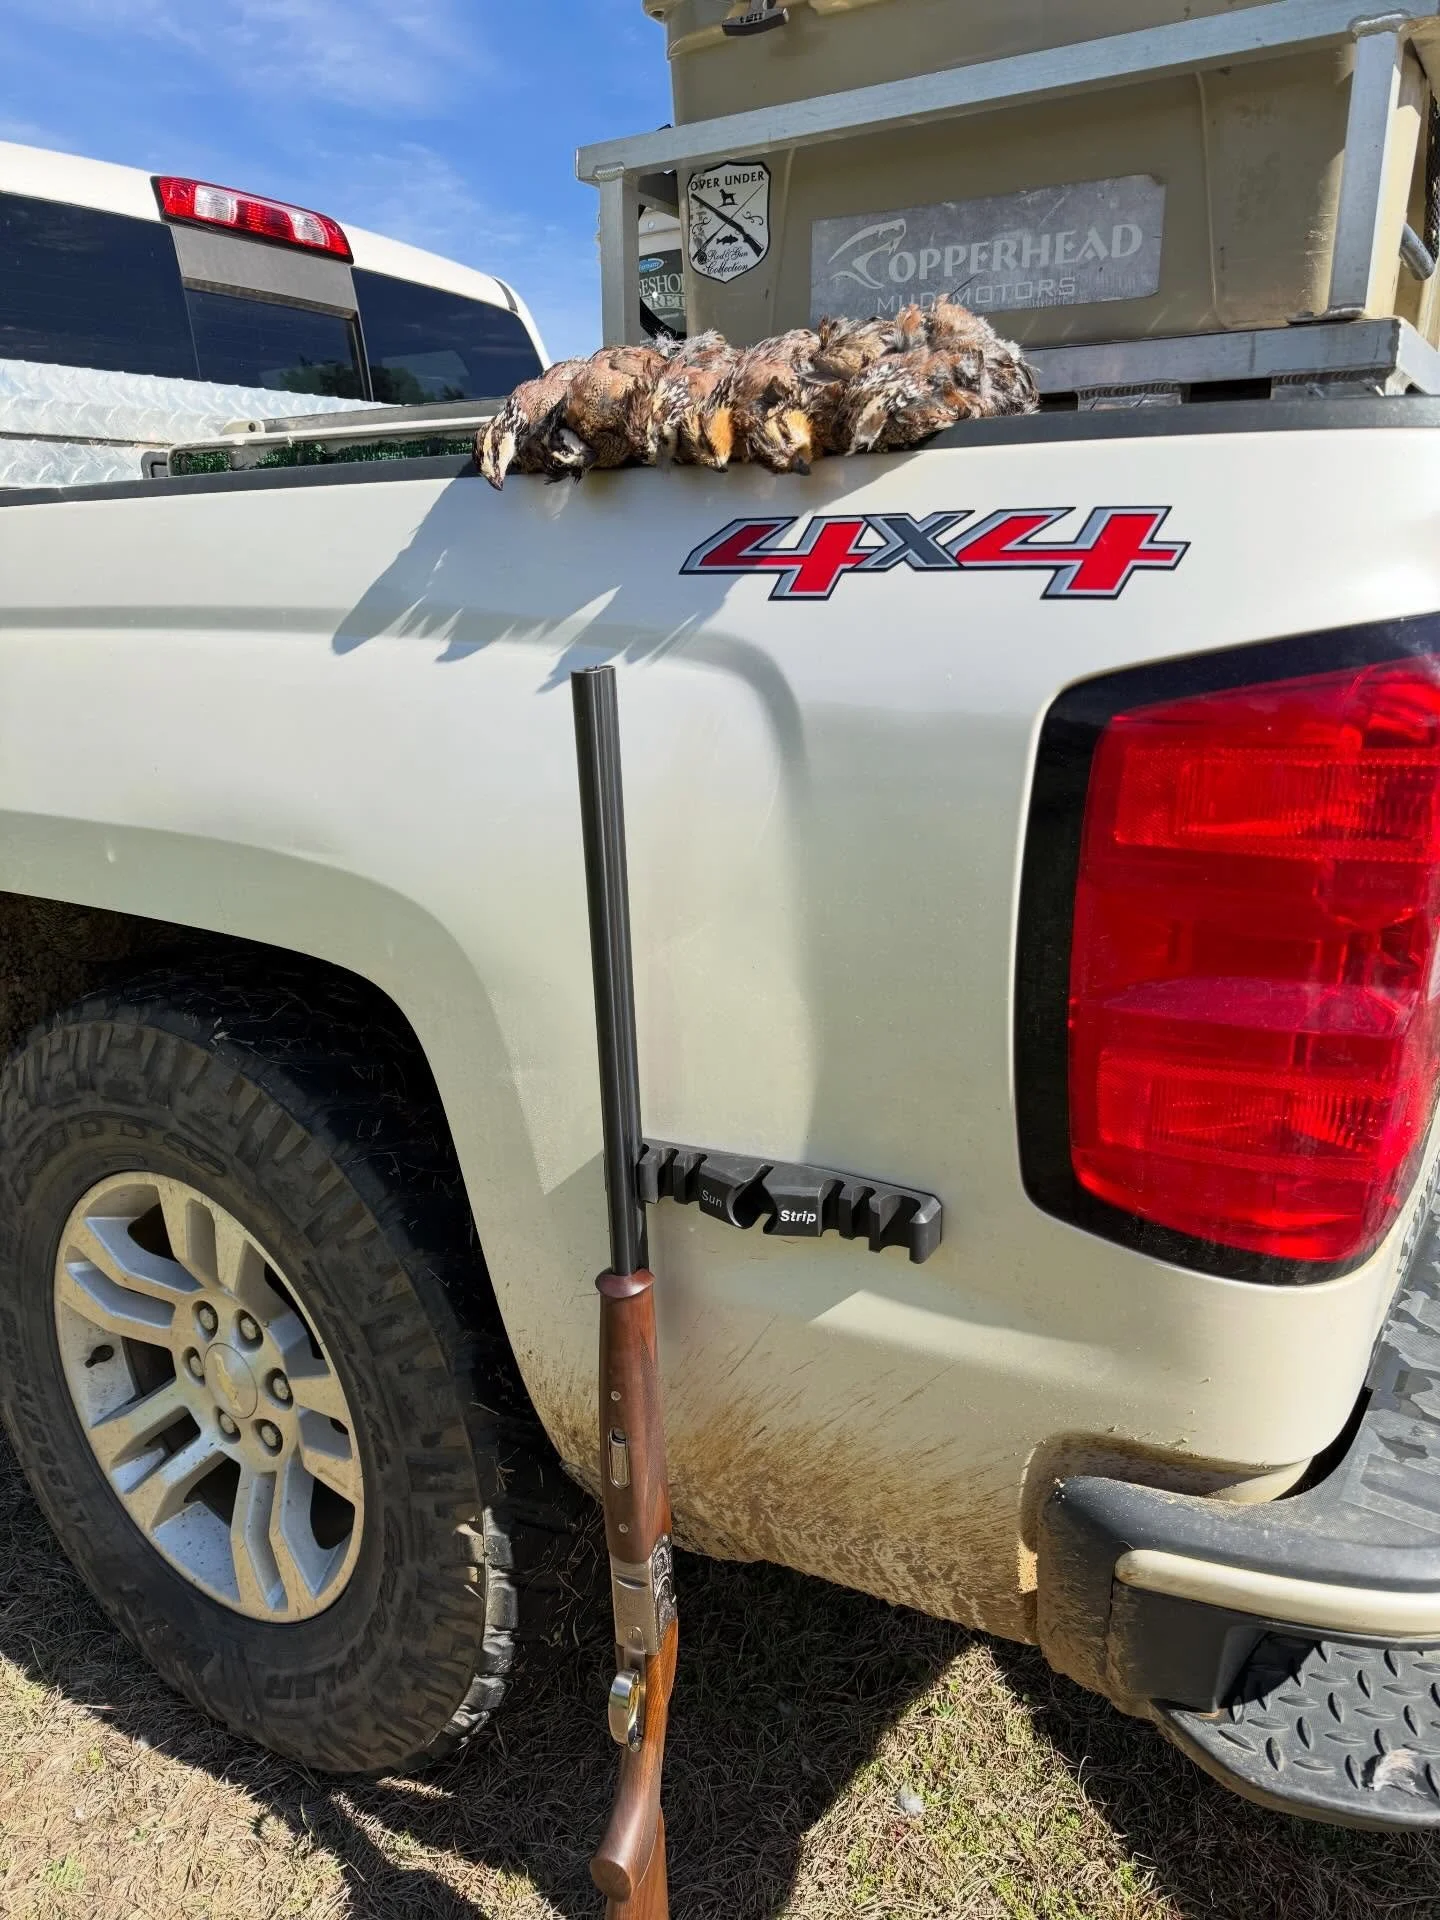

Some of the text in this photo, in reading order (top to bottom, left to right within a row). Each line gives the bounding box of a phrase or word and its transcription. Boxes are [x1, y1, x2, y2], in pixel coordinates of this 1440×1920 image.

[690, 171, 765, 191] OVER UNDER
[705, 260, 748, 277] Collection
[876, 276, 1076, 314] MUD MOTORS
[701, 1189, 817, 1225] Sun Strip
